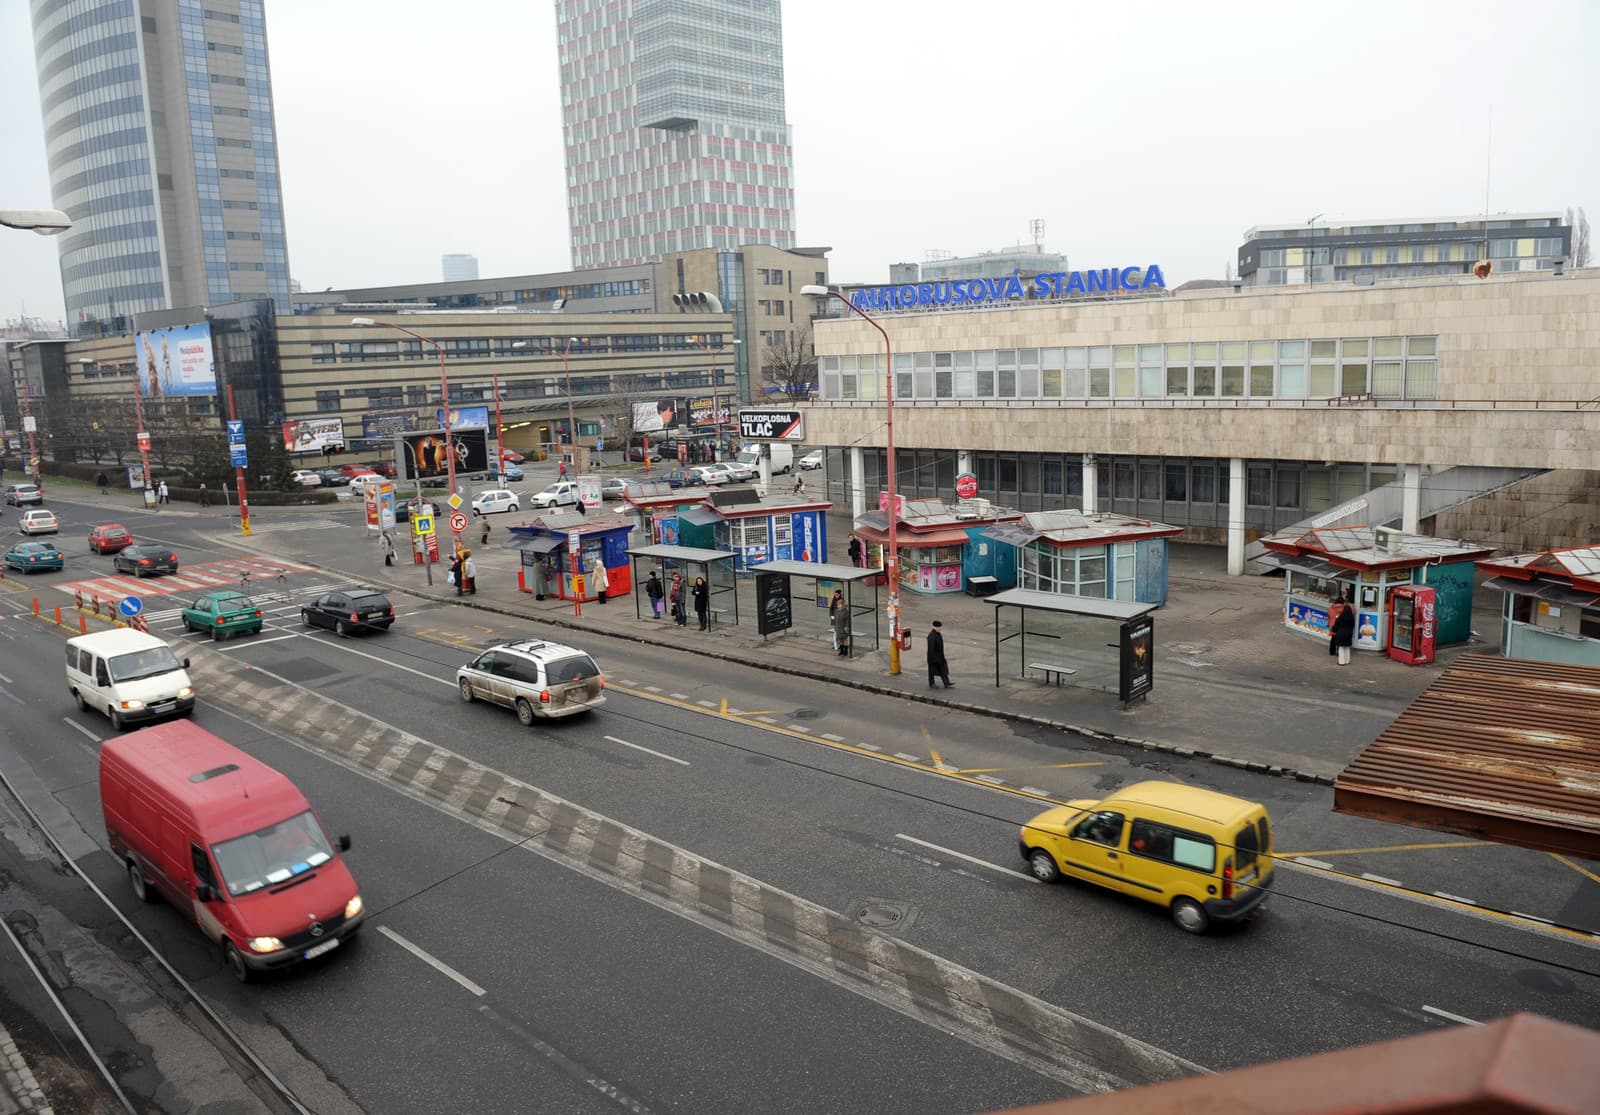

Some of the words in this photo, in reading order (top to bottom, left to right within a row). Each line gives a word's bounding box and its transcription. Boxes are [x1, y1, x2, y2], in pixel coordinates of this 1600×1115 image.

[854, 267, 1025, 309] AUTOBUSOVÁ
[1033, 264, 1166, 298] STANICA
[741, 422, 773, 437] TLAČ
[804, 516, 813, 550] PEPSI
